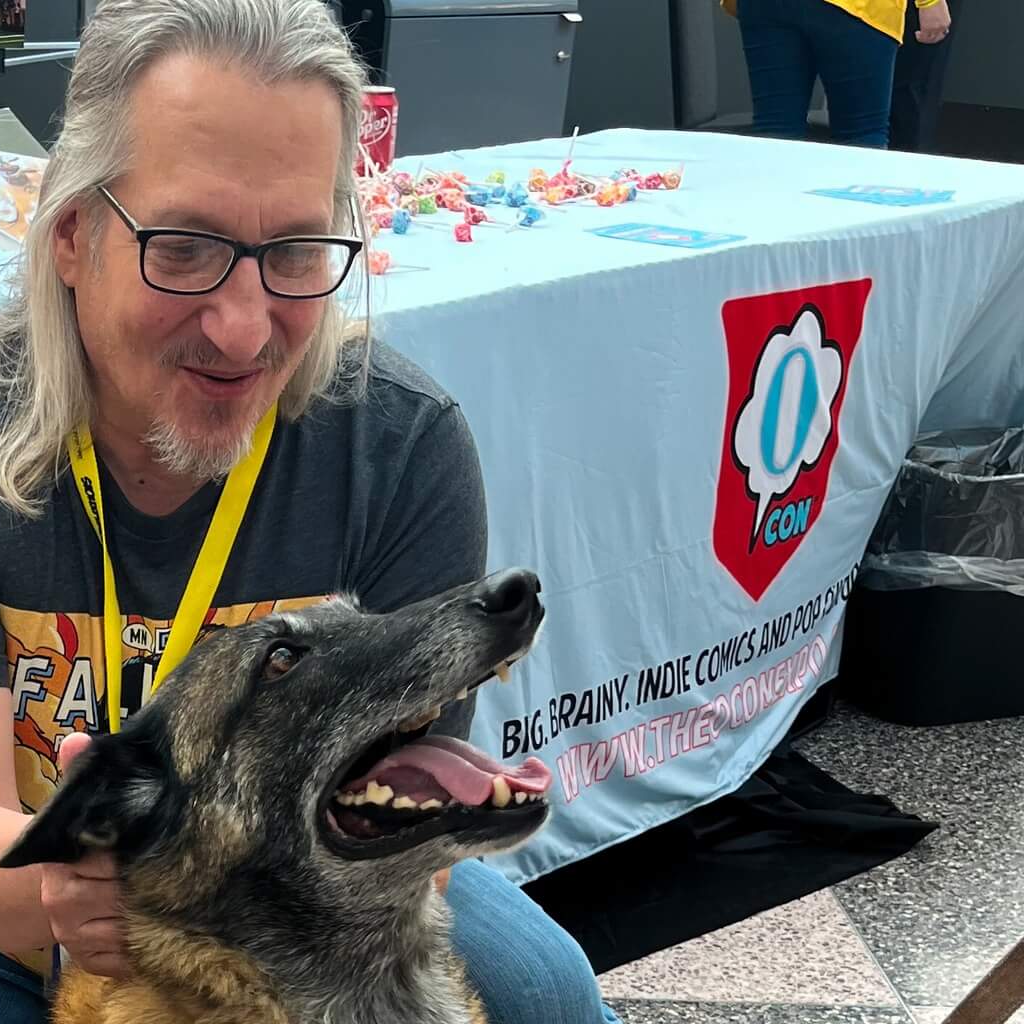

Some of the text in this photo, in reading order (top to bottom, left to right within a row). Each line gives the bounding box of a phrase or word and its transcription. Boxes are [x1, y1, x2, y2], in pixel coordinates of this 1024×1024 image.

[763, 497, 812, 545] CON
[129, 627, 148, 646] MN
[502, 708, 548, 760] BIG.
[549, 674, 630, 739] BRAINY.
[636, 655, 692, 706] INDIE
[694, 627, 756, 686] COMICS
[756, 612, 792, 659] AND
